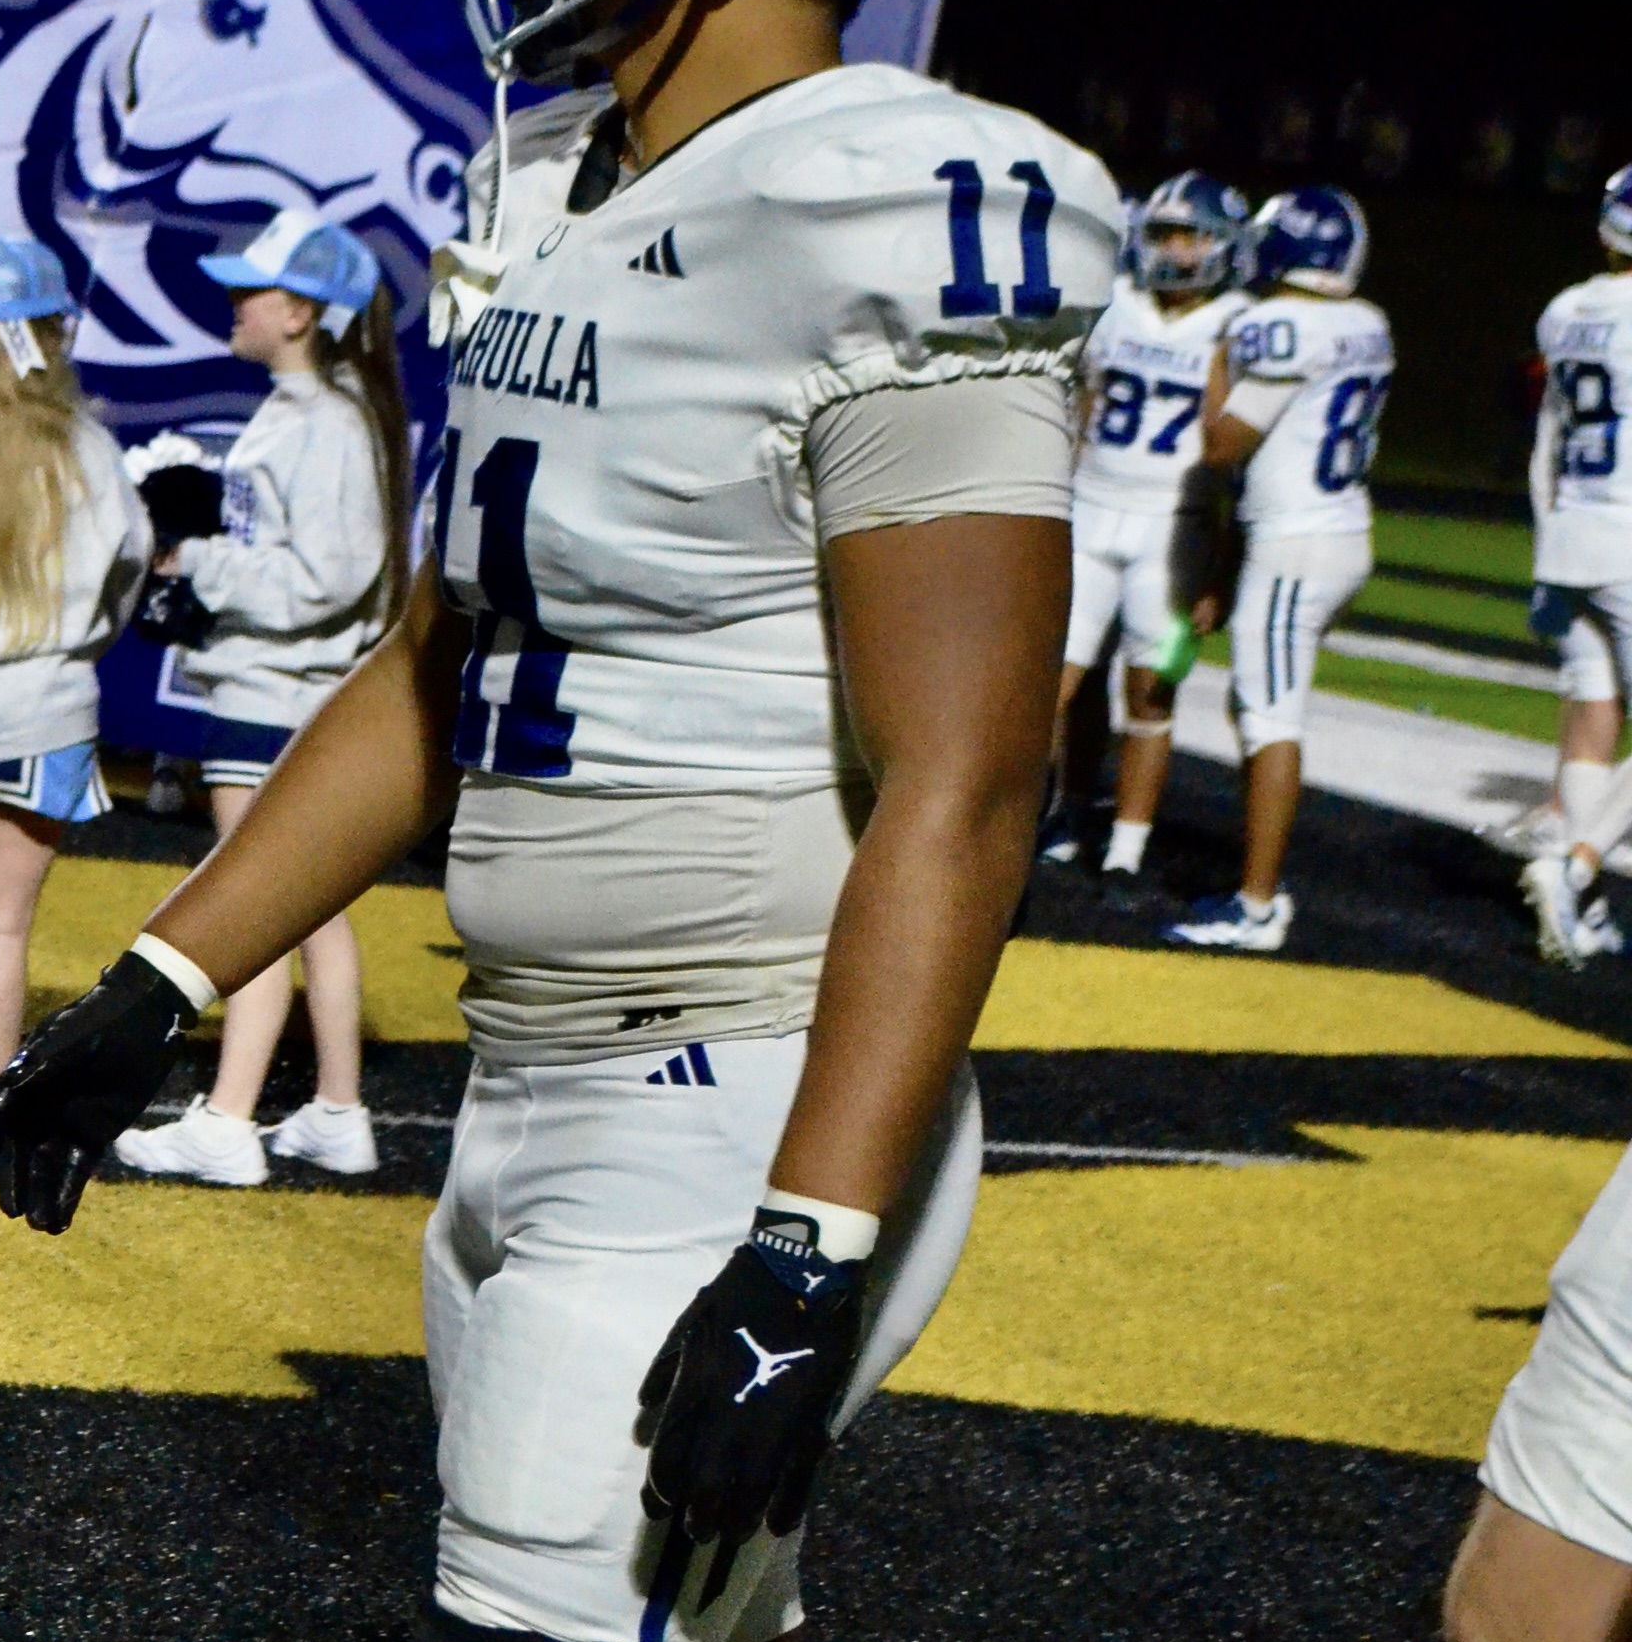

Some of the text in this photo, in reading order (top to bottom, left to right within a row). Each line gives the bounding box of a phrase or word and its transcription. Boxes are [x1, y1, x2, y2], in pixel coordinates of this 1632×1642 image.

[933, 160, 1061, 318] 11
[1097, 367, 1203, 454] 87
[1314, 375, 1392, 493] 8
